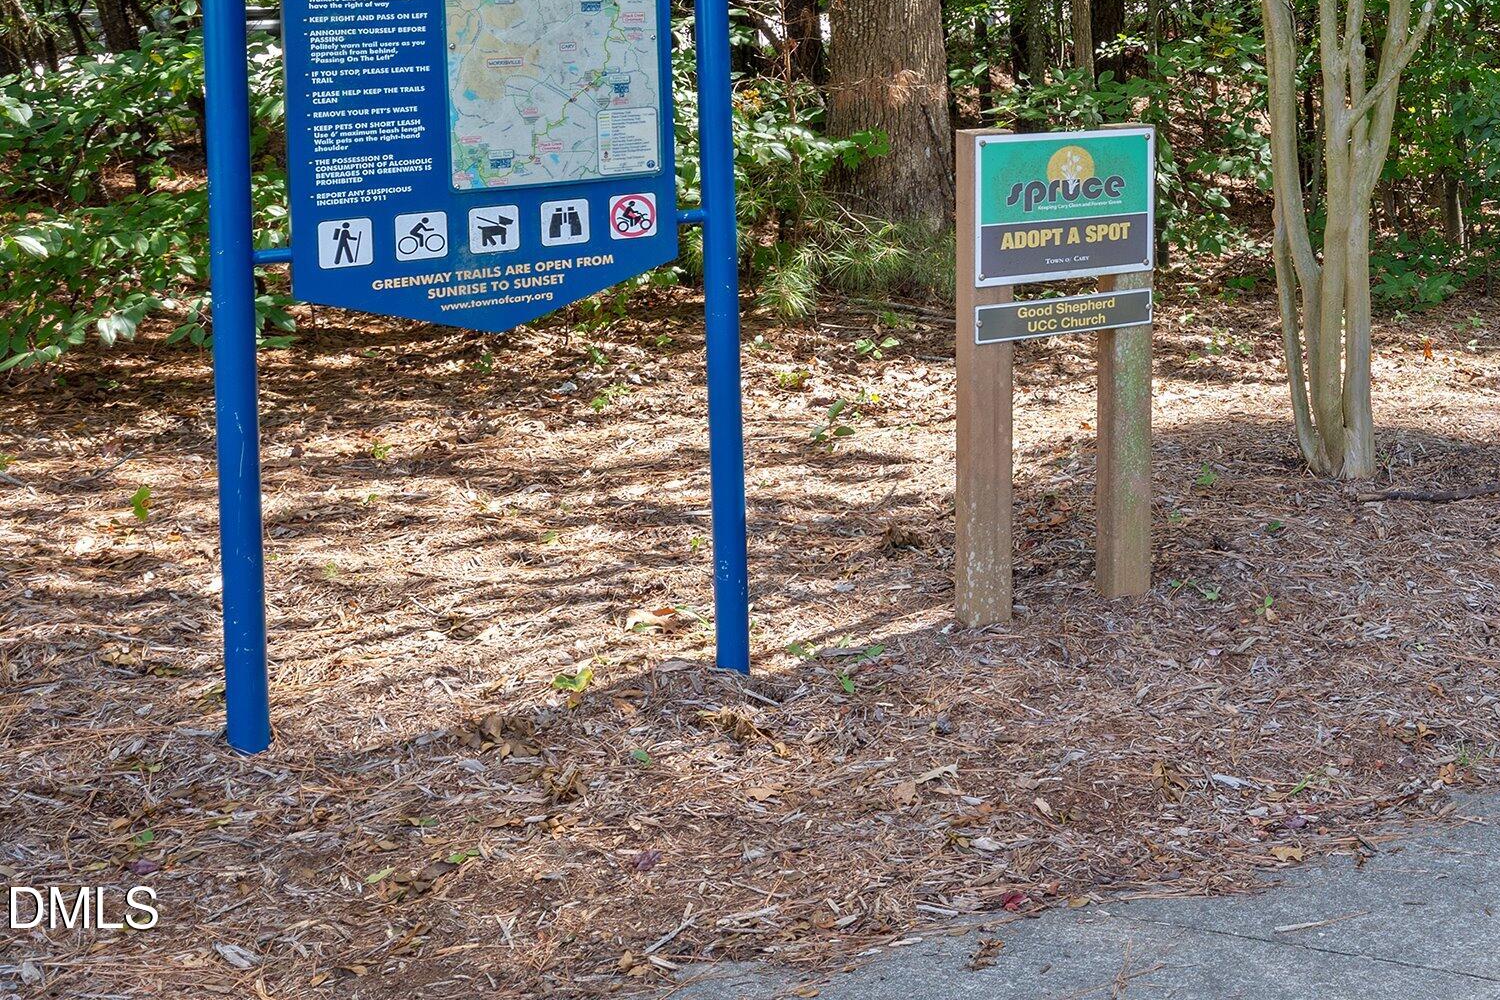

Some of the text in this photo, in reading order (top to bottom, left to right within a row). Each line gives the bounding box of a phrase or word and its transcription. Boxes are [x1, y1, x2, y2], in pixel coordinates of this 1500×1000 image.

[310, 29, 356, 37] ANNOUNCE
[310, 43, 338, 51] Politely
[311, 50, 347, 58] approach
[370, 47, 398, 55] behind,
[340, 129, 377, 137] maximum
[401, 125, 425, 134] length
[380, 133, 420, 142] right-hand
[316, 162, 375, 172] CONSUMPTION
[389, 158, 432, 167] ALCOHOLIC
[332, 155, 381, 164] POSSESSION
[316, 170, 361, 179] BEVERAGES
[377, 166, 423, 174] GREENWAYS
[316, 177, 363, 186] PROHIBITED
[317, 192, 346, 200] REPORT
[367, 186, 412, 195] SUSPICIOUS
[1006, 175, 1126, 213] spruce
[317, 197, 359, 206] INCIDENTS
[1000, 222, 1131, 250] ADOPT A SPOT
[372, 254, 614, 291] GREENWAY TRAILS ARE OPEN FROM
[428, 274, 564, 300] SUNRISE TO SUNSET
[441, 290, 554, 312] www.townofcary.org
[1017, 297, 1115, 319] Good Shepherd
[1027, 314, 1106, 333] UCC Church
